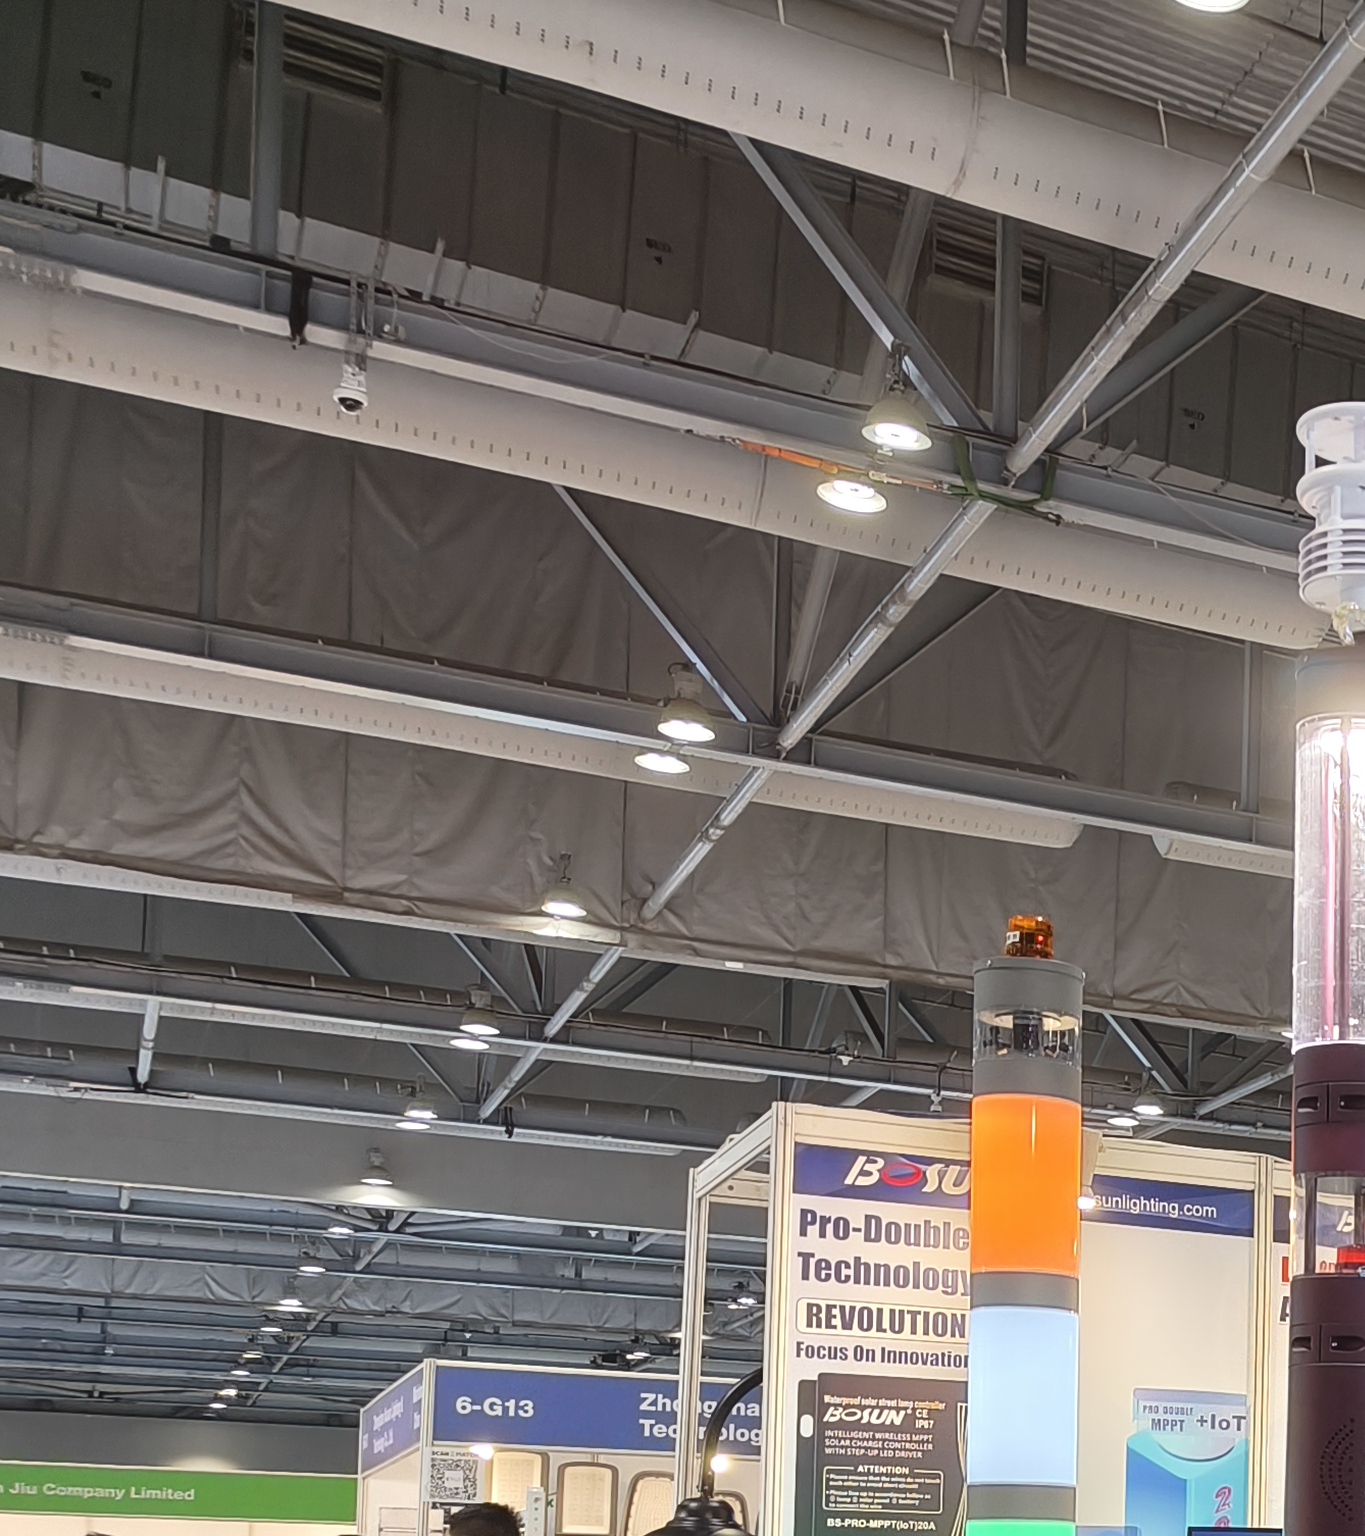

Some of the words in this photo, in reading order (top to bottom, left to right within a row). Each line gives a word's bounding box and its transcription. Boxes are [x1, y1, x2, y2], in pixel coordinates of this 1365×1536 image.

[844, 1155, 970, 1195] BOSU
[1093, 1194, 1217, 1218] sunlighting.com
[799, 1208, 969, 1251] Pro-Double
[806, 1303, 966, 1338] REVOLUTION
[796, 1341, 848, 1361] Focus
[853, 1344, 875, 1363] On
[455, 1396, 534, 1417] 6-G13
[823, 1406, 906, 1425] BOSUN
[915, 1409, 929, 1418] CE
[1142, 1405, 1160, 1414] PRO
[1163, 1406, 1194, 1416] DOUBLE
[1151, 1418, 1185, 1432] MPPT
[1196, 1413, 1247, 1432] +IoT
[825, 1430, 873, 1439] INTELLIGENT
[875, 1432, 910, 1440] WIRELESS
[825, 1438, 850, 1446] SOLAR
[884, 1441, 933, 1450] CONTROLLER
[825, 1447, 845, 1455] WITH
[846, 1448, 878, 1457] STEP-UP
[880, 1449, 893, 1457] LED
[895, 1450, 922, 1458] DRIVER
[857, 1465, 910, 1474] ATTENTION
[9, 1483, 37, 1494] Jiu
[43, 1483, 125, 1500] Company
[130, 1487, 195, 1500] Limited
